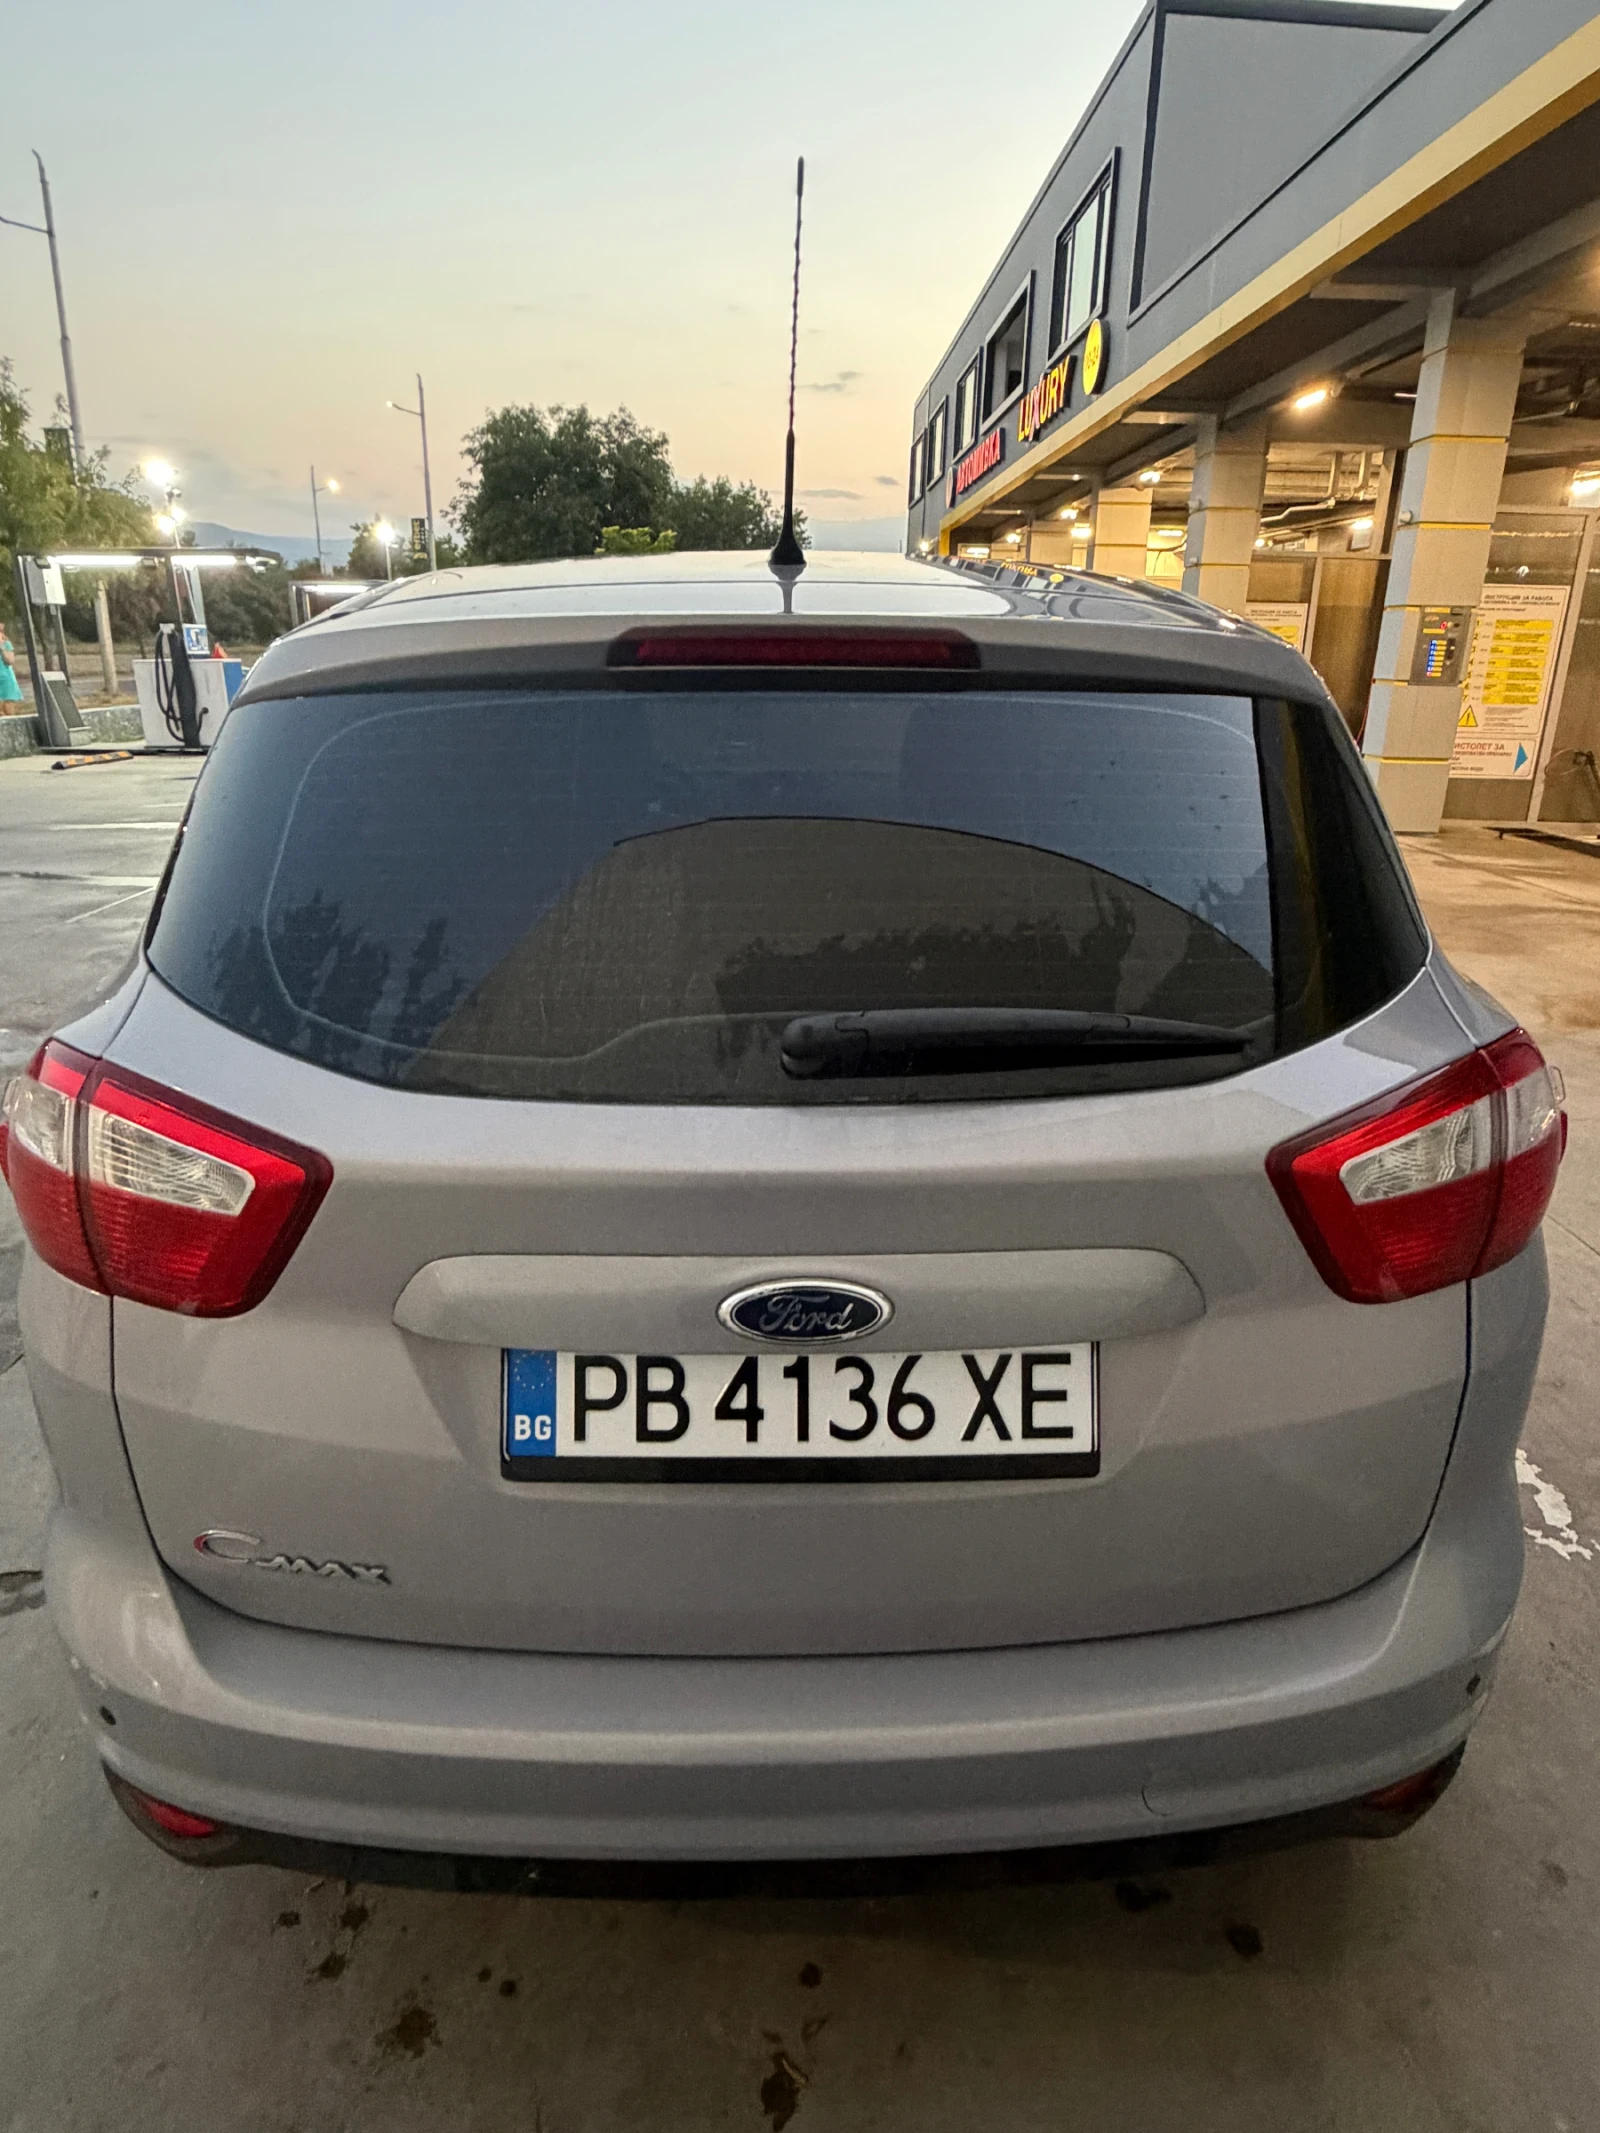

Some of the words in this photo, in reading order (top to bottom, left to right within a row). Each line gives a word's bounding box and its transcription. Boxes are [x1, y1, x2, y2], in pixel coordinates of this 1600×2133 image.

[1018, 354, 1071, 442] LUXURY
[758, 1294, 854, 1331] Ford
[514, 1414, 551, 1440] BG
[574, 1355, 690, 1442] PB
[715, 1355, 936, 1442] 4136
[961, 1352, 1074, 1441] XE
